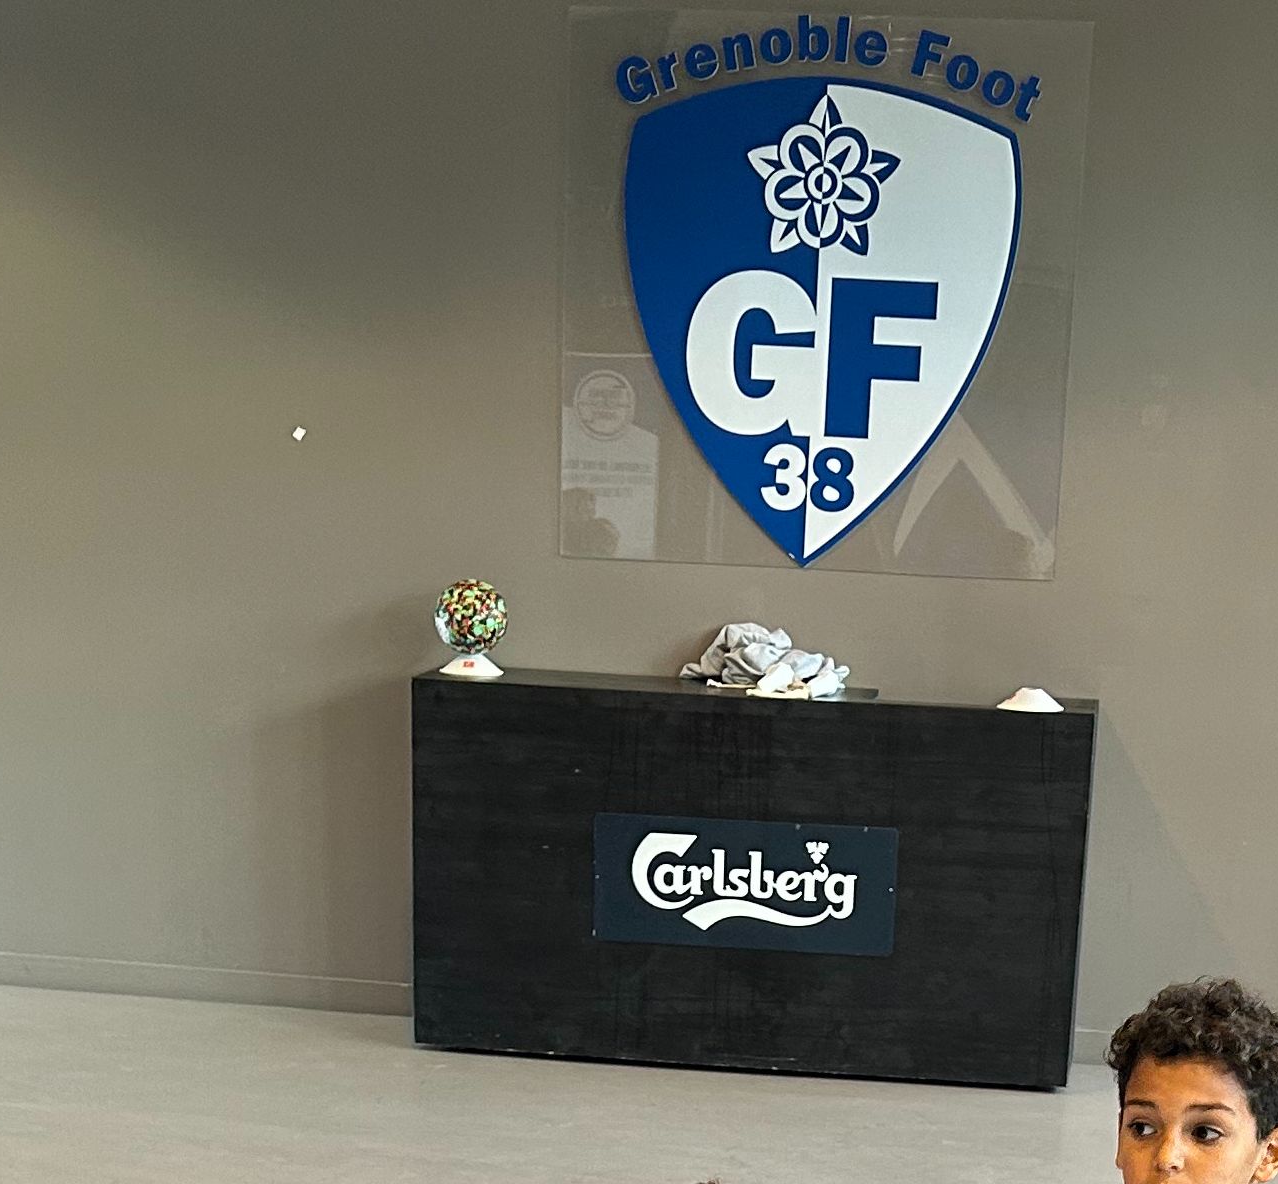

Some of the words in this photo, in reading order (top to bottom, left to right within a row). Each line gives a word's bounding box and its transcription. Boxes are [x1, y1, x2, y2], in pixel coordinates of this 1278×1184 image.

[616, 15, 889, 104] Grenoble
[910, 29, 1042, 122] Foot
[686, 269, 939, 440] GF
[760, 442, 855, 512] 38
[631, 832, 857, 930] Carlsberg
